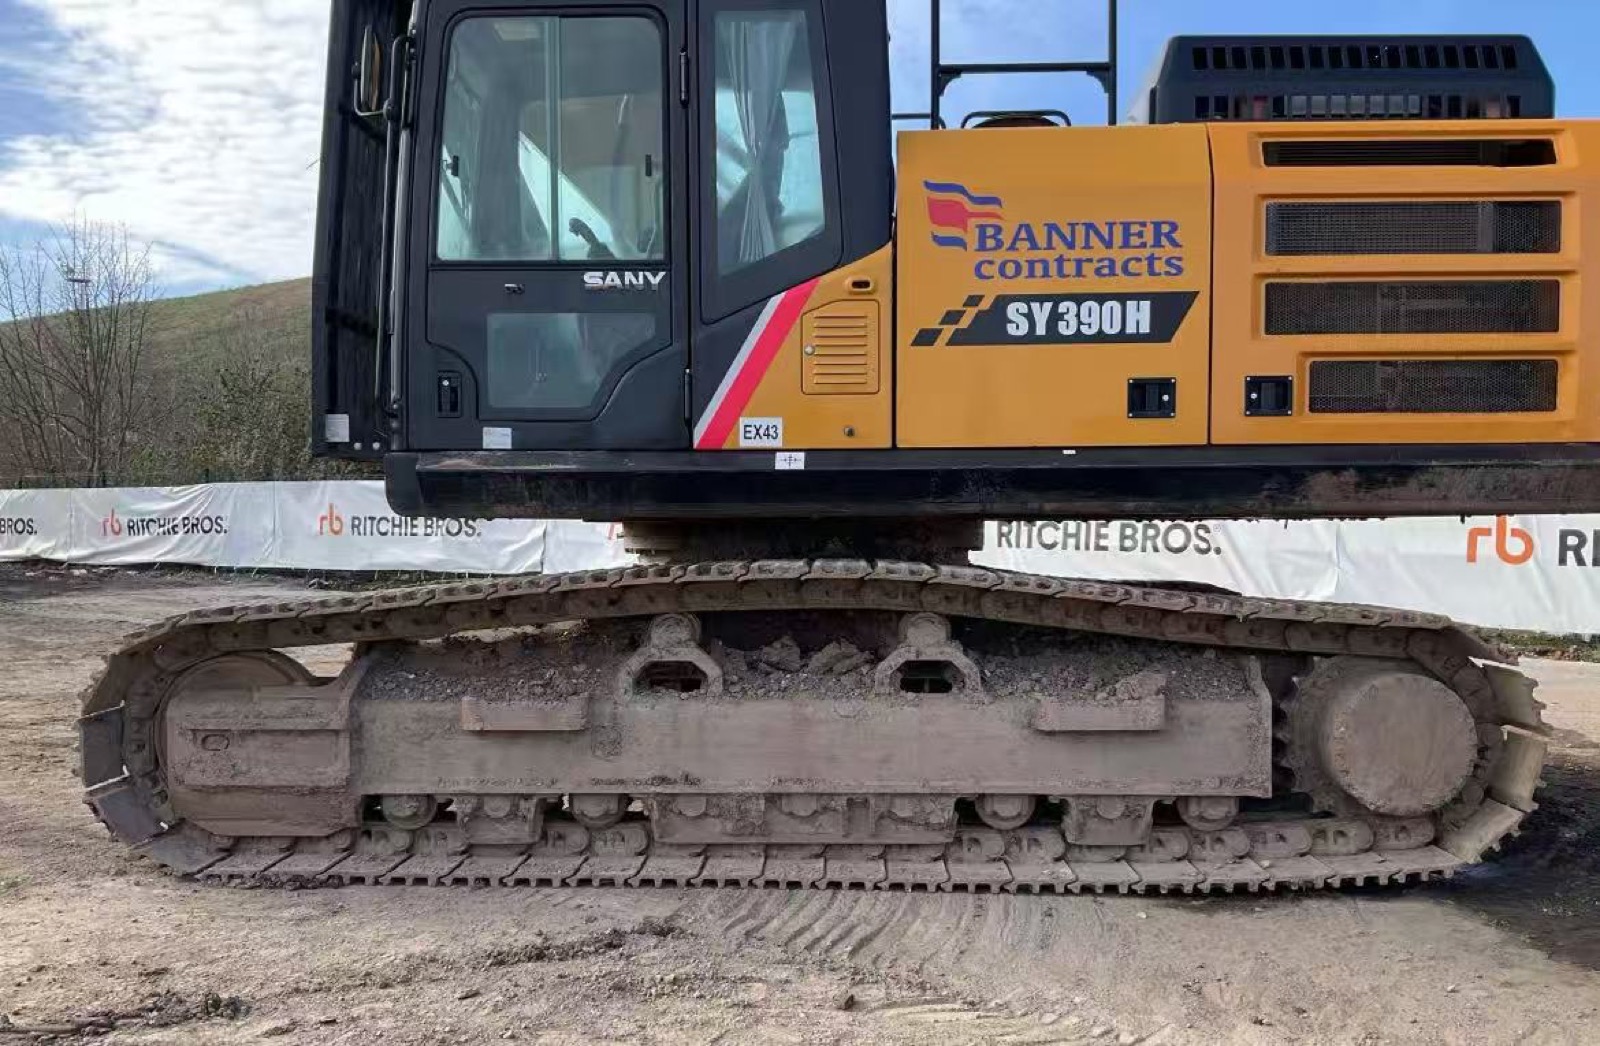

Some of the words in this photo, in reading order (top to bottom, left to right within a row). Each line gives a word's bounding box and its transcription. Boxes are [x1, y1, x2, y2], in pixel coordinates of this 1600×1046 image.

[974, 220, 1183, 251] BANNER
[974, 252, 1185, 279] contracts
[583, 271, 667, 291] SANY
[743, 424, 778, 440] EX43
[0, 517, 38, 535] BROS.
[126, 516, 179, 536] RITCHIE
[182, 515, 228, 534] BROS.
[351, 516, 419, 537] RITCHIE
[424, 516, 482, 537] BROS.
[998, 520, 1109, 551] RITCHIE
[1119, 521, 1222, 555] BROS.
[1466, 512, 1534, 565] rb
